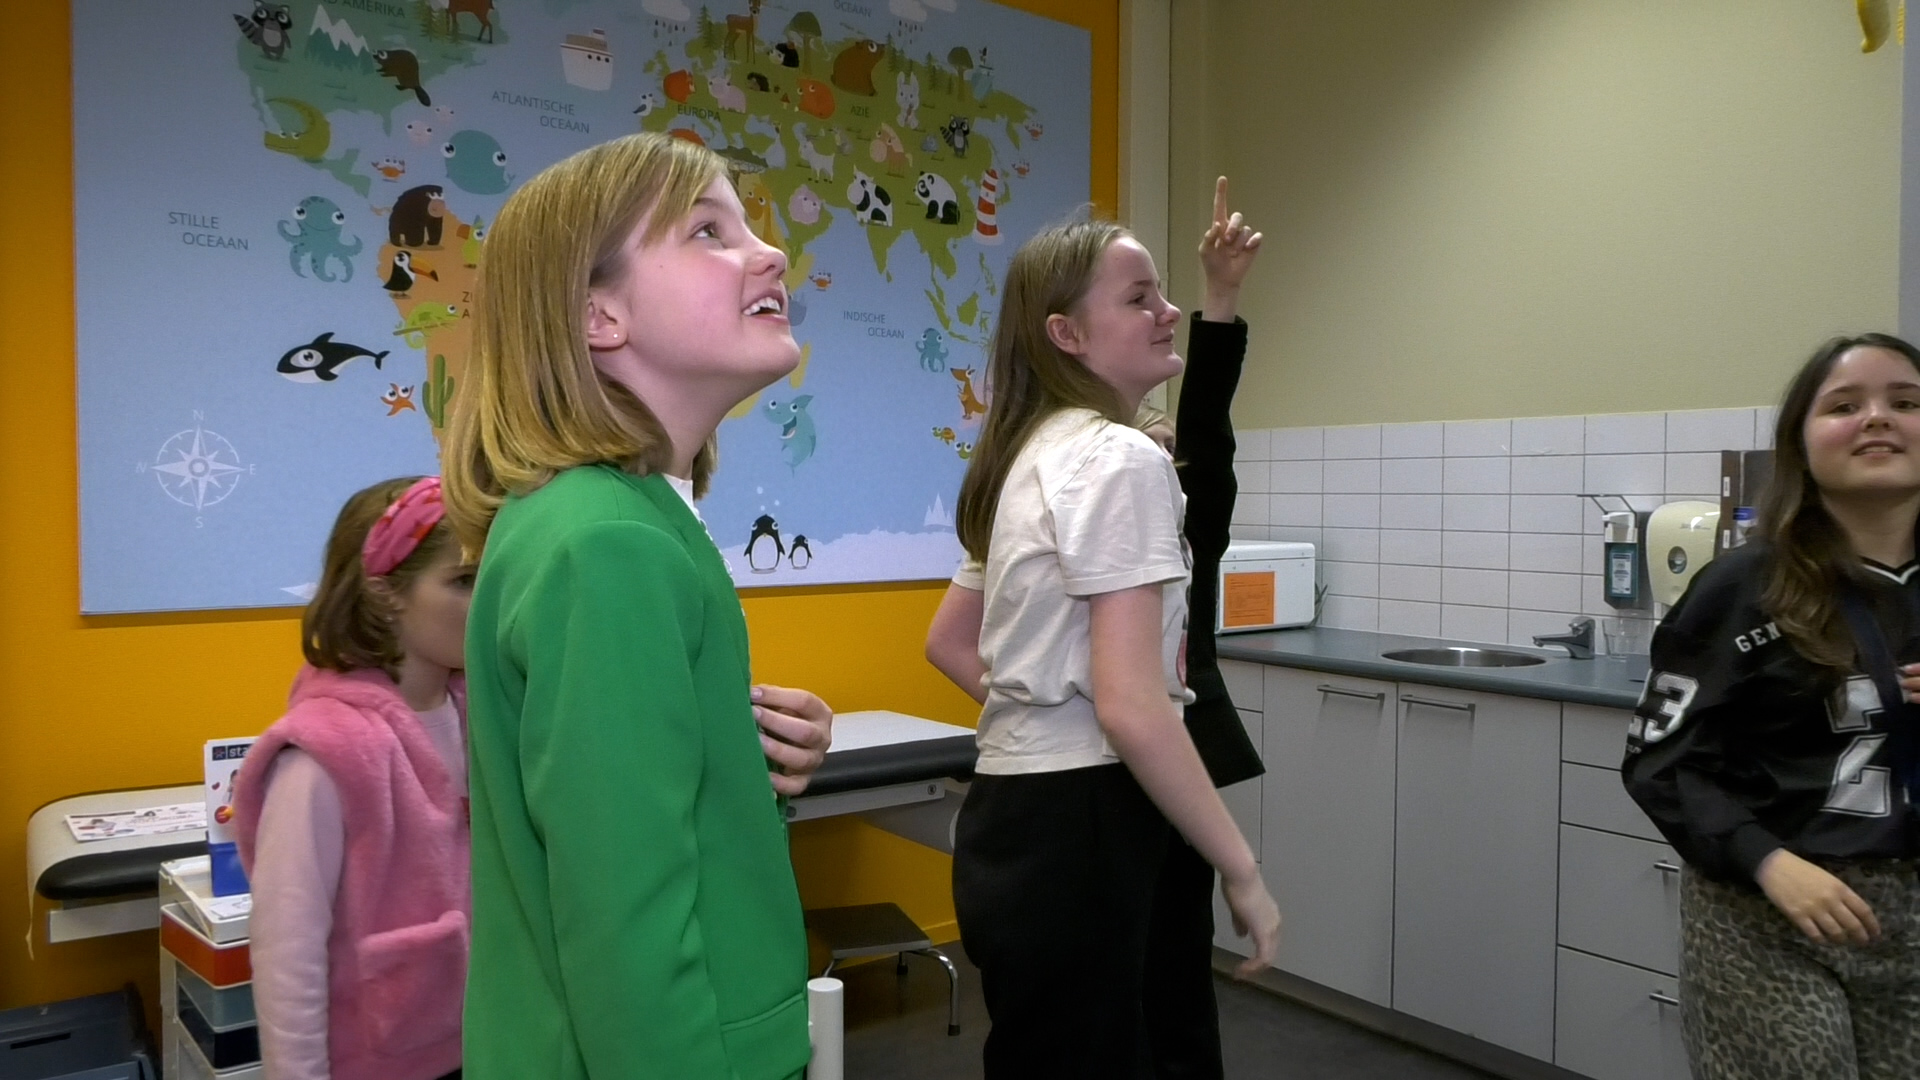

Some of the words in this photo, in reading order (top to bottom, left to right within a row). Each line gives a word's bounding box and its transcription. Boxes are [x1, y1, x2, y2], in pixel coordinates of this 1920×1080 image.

[341, 0, 406, 18] AMERIKA
[491, 90, 576, 116] ATLANTISCHE
[677, 104, 721, 122] EUROPA
[540, 115, 590, 134] OCEAAN
[168, 211, 219, 230] STILLE
[182, 231, 249, 250] OCEAAN
[843, 310, 886, 324] INDISCHE
[867, 326, 905, 340] OCEAAN
[192, 409, 204, 421] N
[249, 463, 257, 476] E
[195, 516, 204, 529] S
